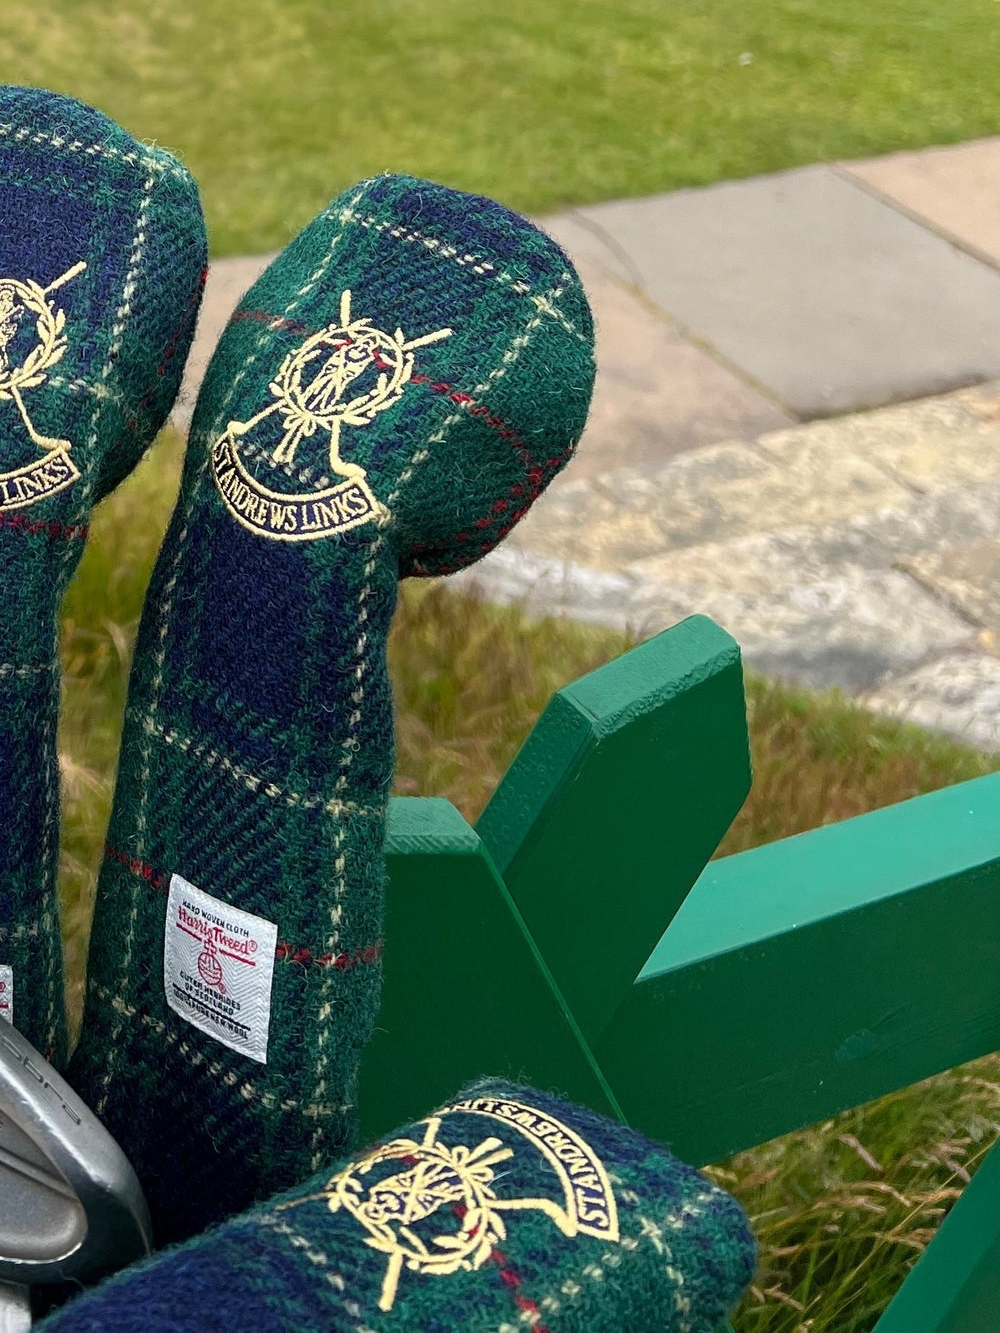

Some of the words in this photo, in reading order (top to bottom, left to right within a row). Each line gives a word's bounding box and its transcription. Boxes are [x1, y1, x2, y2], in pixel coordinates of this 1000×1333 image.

[214, 441, 233, 474] ST
[1, 455, 70, 505] LINKS
[219, 467, 298, 532] ANDREWS
[299, 487, 369, 531] LINKS
[178, 905, 213, 940] Harris
[202, 909, 226, 928] WOVEN
[225, 923, 250, 938] CLOTH
[497, 1104, 604, 1194] ANDREWS
[575, 1187, 610, 1228] ST
